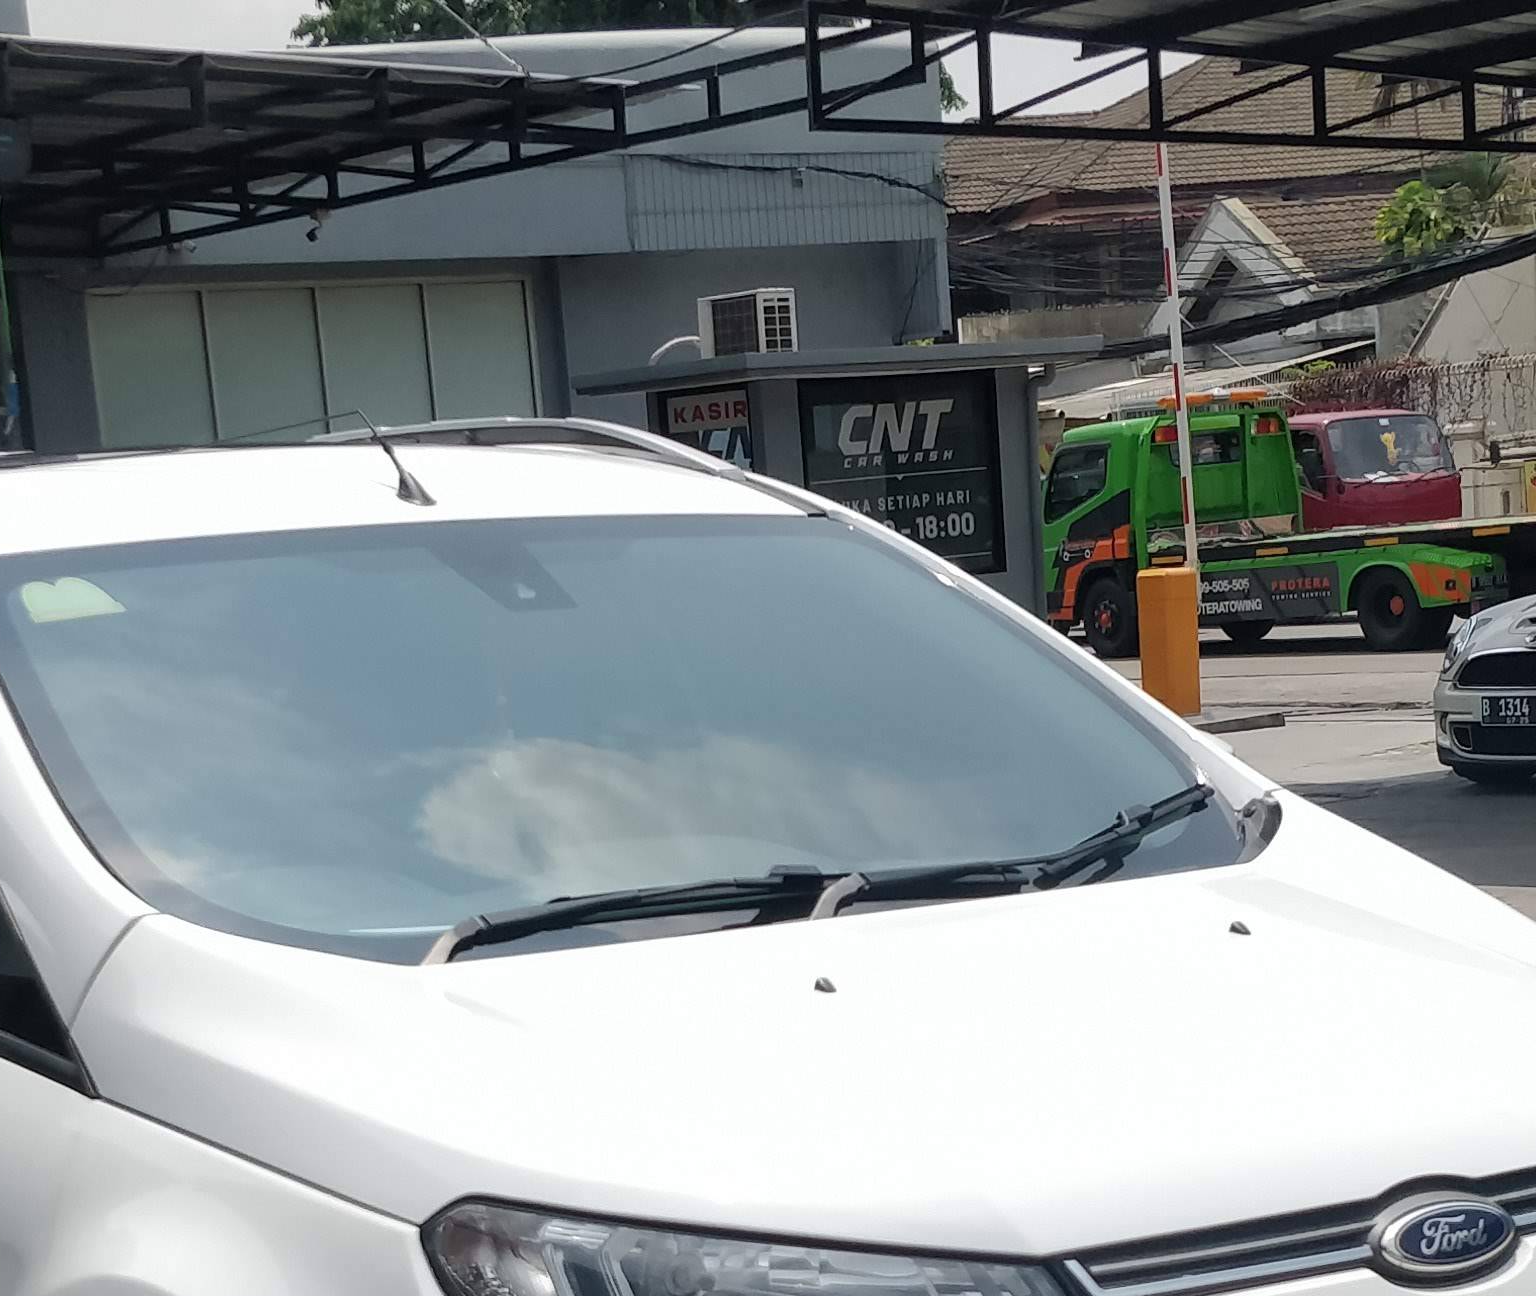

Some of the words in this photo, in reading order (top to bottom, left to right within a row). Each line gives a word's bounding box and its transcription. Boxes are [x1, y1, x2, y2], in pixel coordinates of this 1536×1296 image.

[674, 400, 747, 425] KASIR
[838, 398, 955, 456] CNT
[843, 453, 883, 469] CAR
[897, 449, 954, 465] WASH
[877, 492, 930, 511] SETIAP
[936, 490, 971, 506] HARI
[916, 512, 976, 540] 18:00
[1271, 577, 1330, 591] PROTERA
[1482, 698, 1490, 716] B
[1498, 698, 1530, 717] 1314
[1420, 1213, 1488, 1256] Ford
